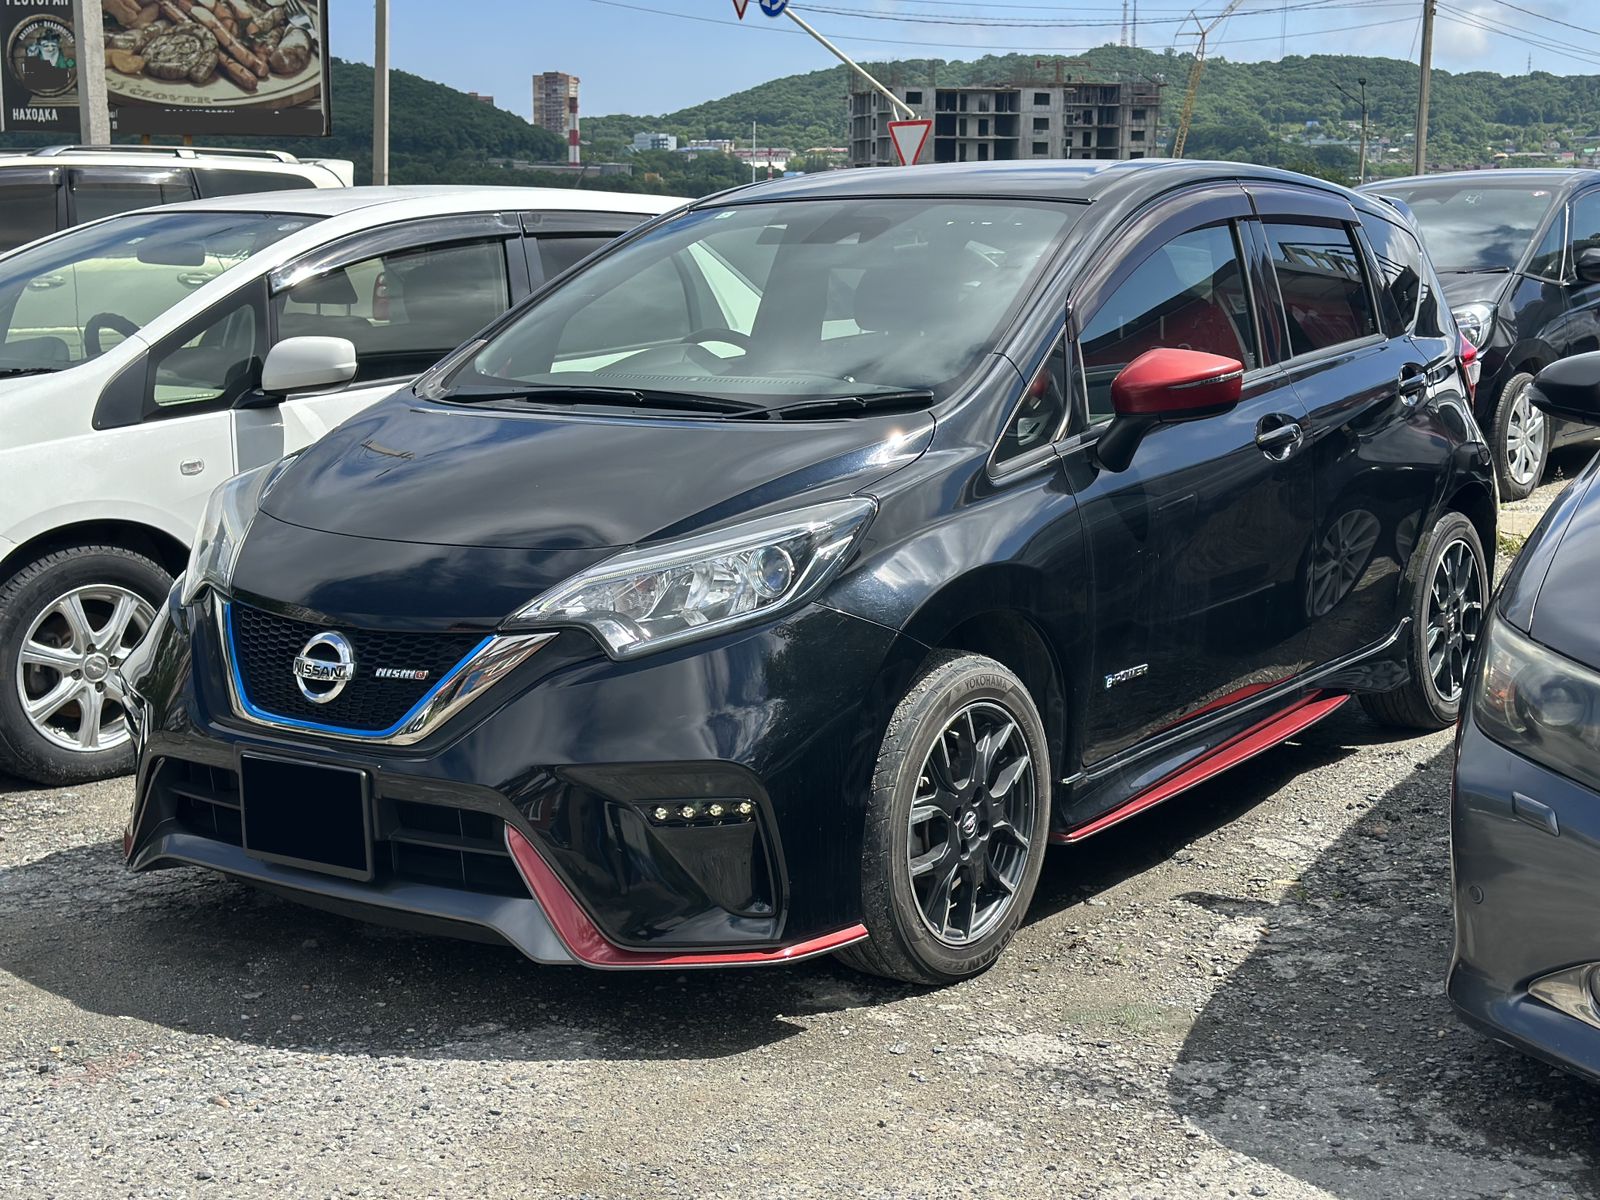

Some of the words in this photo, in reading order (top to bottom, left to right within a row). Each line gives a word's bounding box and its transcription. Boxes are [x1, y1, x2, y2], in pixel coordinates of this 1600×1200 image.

[12, 108, 58, 123] НАХОДКА
[294, 658, 347, 680] NISSAN
[964, 675, 1008, 691] YOKOHAMA
